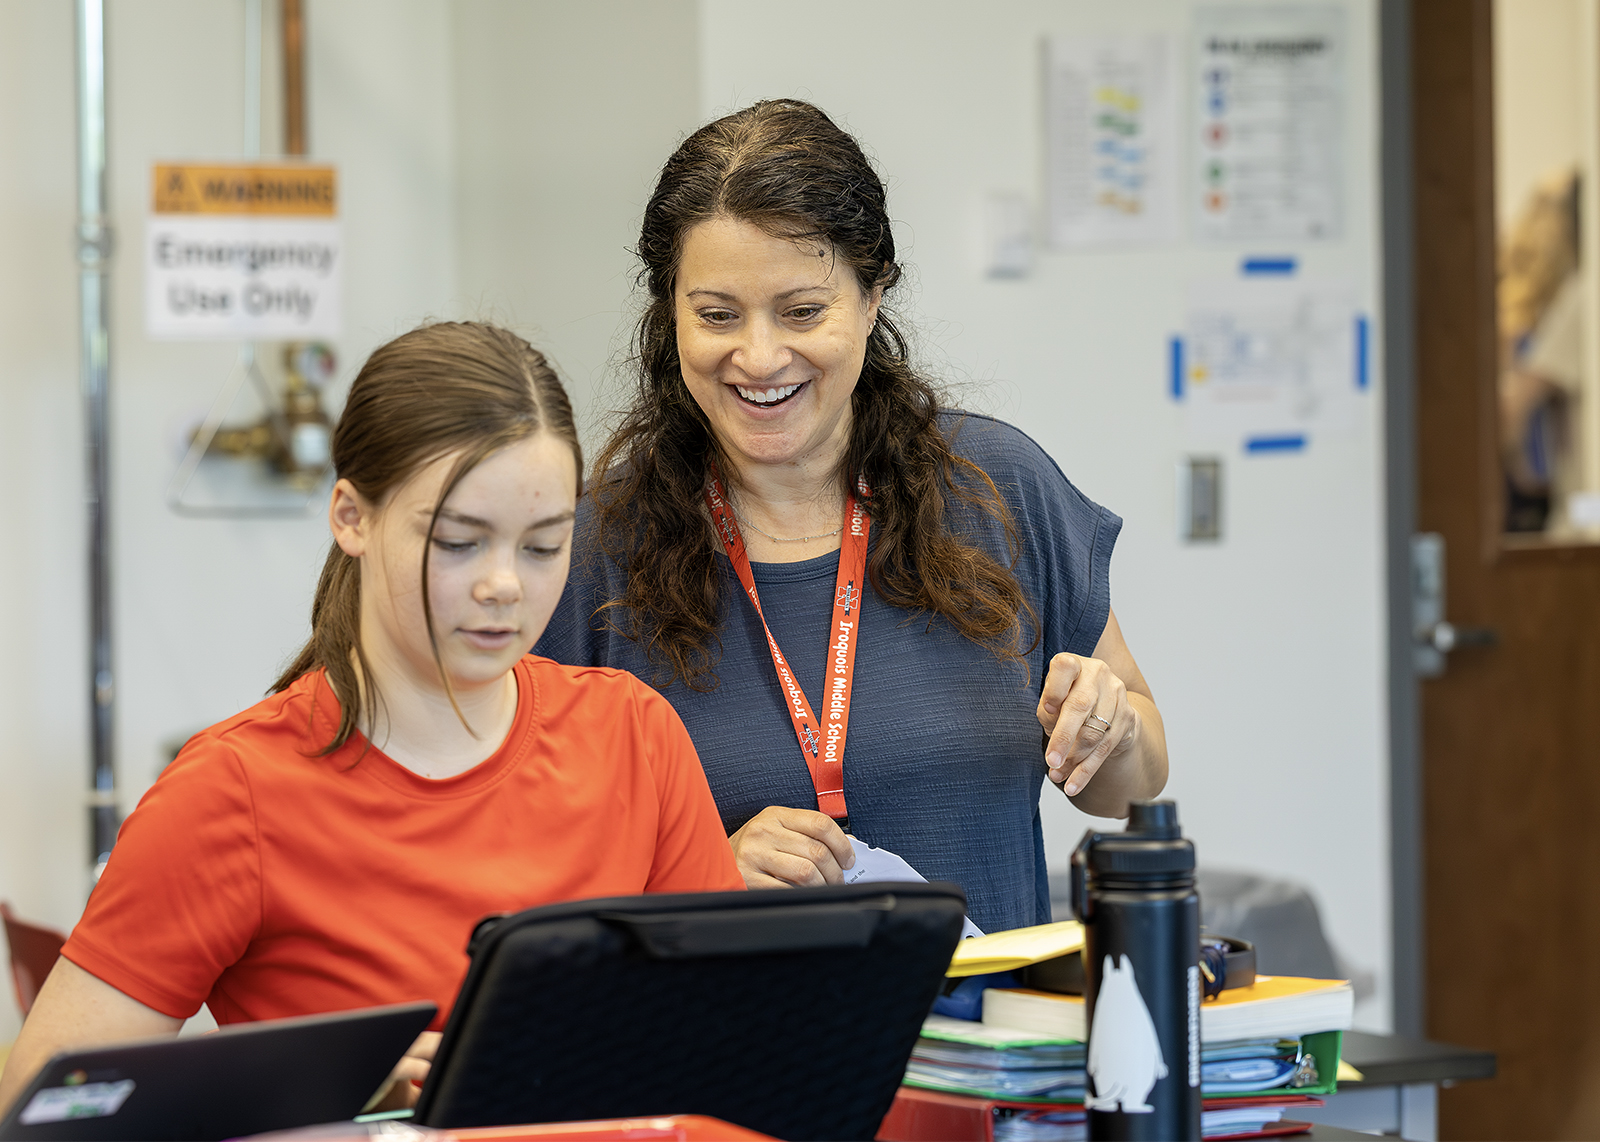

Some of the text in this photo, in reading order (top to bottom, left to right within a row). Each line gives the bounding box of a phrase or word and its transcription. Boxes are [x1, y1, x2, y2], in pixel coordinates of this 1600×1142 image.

[202, 180, 334, 204] WARNING
[154, 234, 336, 279] Emergency
[167, 281, 318, 325] Use Only
[851, 503, 866, 537] chool
[833, 620, 854, 674] Iroquois
[780, 667, 808, 719] Iroquois
[829, 677, 848, 720] Middle
[824, 723, 843, 763] School
